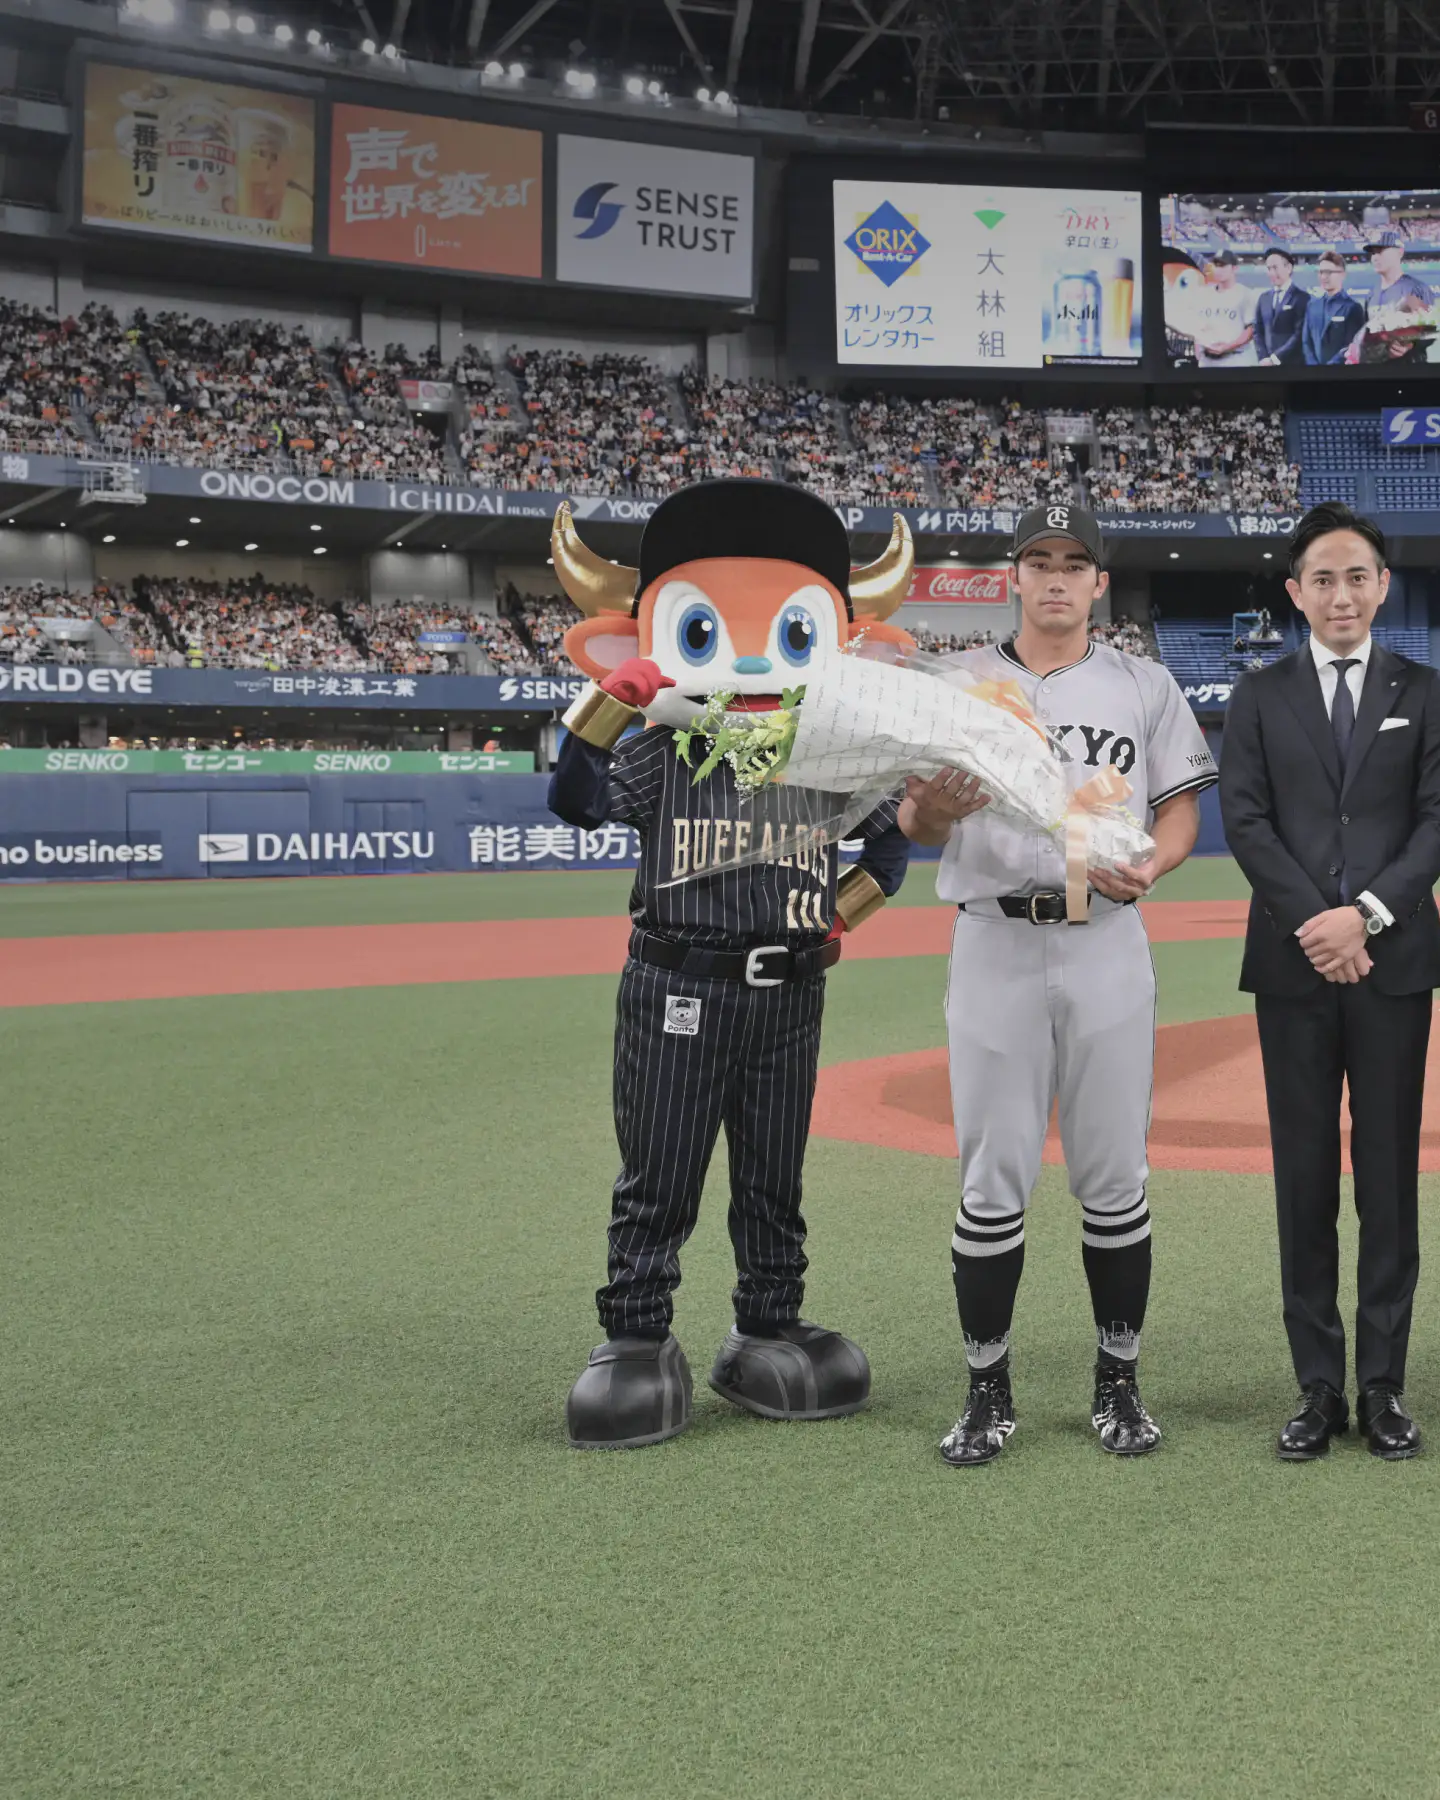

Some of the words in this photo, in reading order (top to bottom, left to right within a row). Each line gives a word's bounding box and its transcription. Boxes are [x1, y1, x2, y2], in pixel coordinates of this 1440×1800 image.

[1424, 109, 1437, 128] G
[132, 111, 158, 197] 一番搾り
[344, 127, 438, 183] 声で
[635, 186, 739, 221] SENSE
[636, 220, 736, 254] TRUST
[855, 227, 918, 251] ORIX
[844, 305, 934, 324] オリックス
[976, 248, 1005, 357] 大林組
[844, 328, 935, 349] レンタカー
[2, 455, 28, 480] 物
[201, 470, 355, 504] ONOCOM
[507, 505, 547, 517] HLDGS
[1097, 519, 1196, 530] ールスフォース・ジャパン
[928, 572, 1005, 598] Coca-Cola
[88, 668, 152, 693] EYE
[45, 753, 129, 771] SENKO
[182, 753, 263, 771] センコー
[313, 754, 391, 771] SENKO
[438, 754, 511, 771] センコー
[35, 839, 163, 864] business
[257, 832, 435, 862] DAIHATSU
[786, 889, 829, 929] 111
